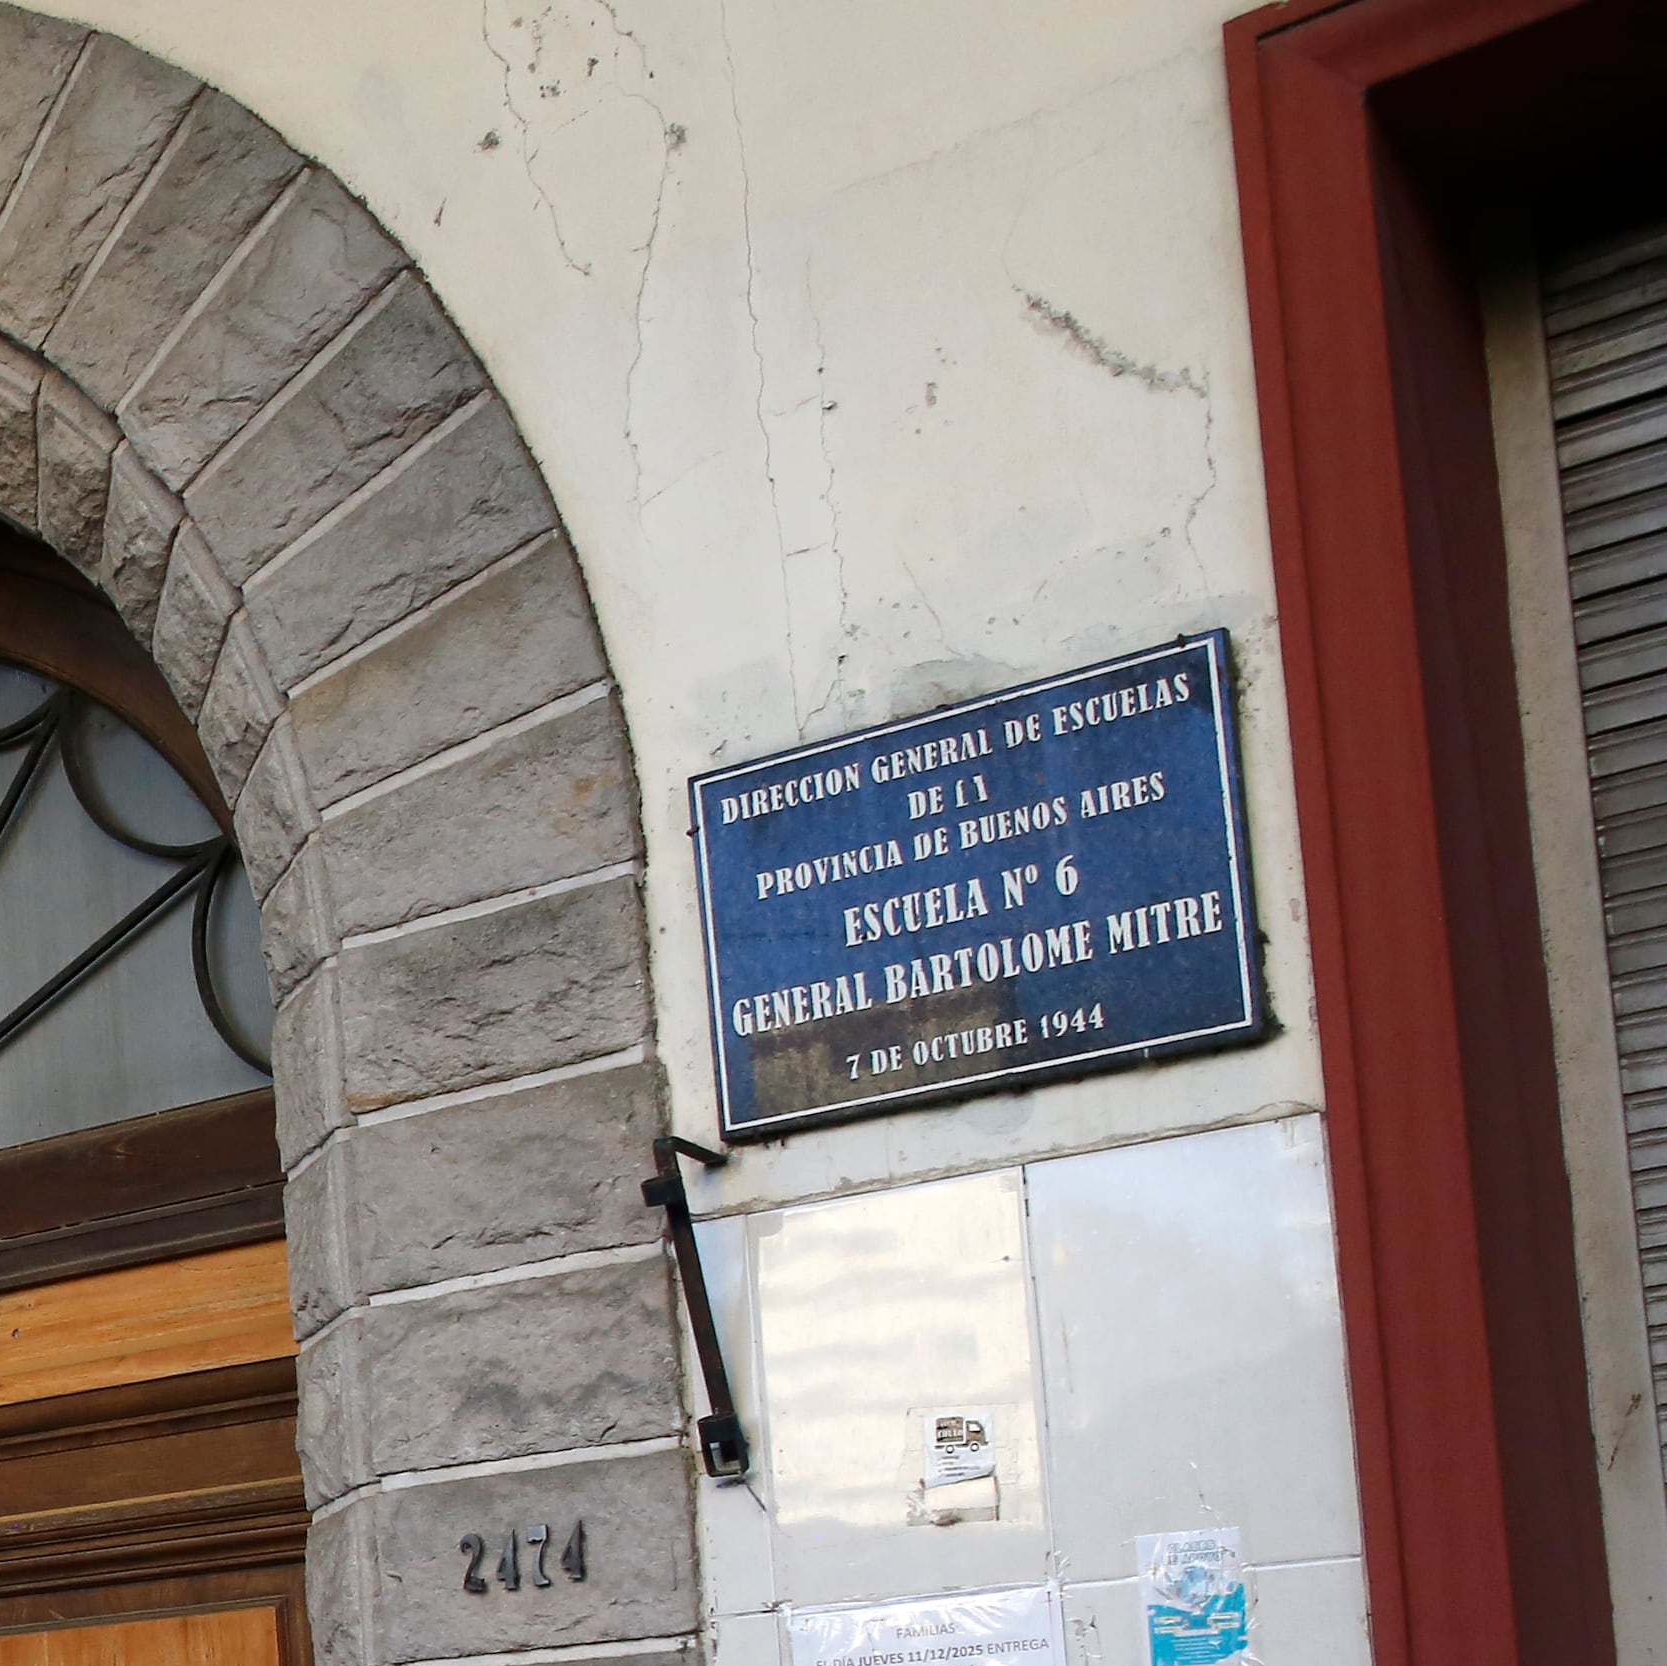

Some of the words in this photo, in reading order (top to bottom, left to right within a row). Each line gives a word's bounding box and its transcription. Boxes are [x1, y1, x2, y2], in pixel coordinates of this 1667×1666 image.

[721, 763, 859, 824] DIRECCION
[872, 730, 992, 783] GENERAL
[1004, 714, 1041, 748] DE
[1052, 673, 1189, 735] ESCUELAS
[757, 840, 902, 899] PROVINCIA
[914, 828, 948, 860] DE
[959, 797, 1067, 849] BUENOS
[1081, 772, 1164, 818] AIRES
[907, 786, 943, 819] DE
[844, 879, 988, 946] ESCUELA
[1056, 855, 1078, 895] 6
[733, 972, 872, 1035] GENERAL
[884, 921, 1093, 1003] BARTOLOME
[1107, 891, 1221, 953] MITRE
[847, 1054, 859, 1079] 7
[871, 1046, 902, 1074] DE
[913, 1020, 1027, 1064] OCTUBRE
[1041, 1003, 1103, 1038] 1944
[459, 1520, 587, 1593] 2474
[907, 1644, 984, 1664] 11/12/2025
[987, 1638, 1049, 1655] ENTREGA
